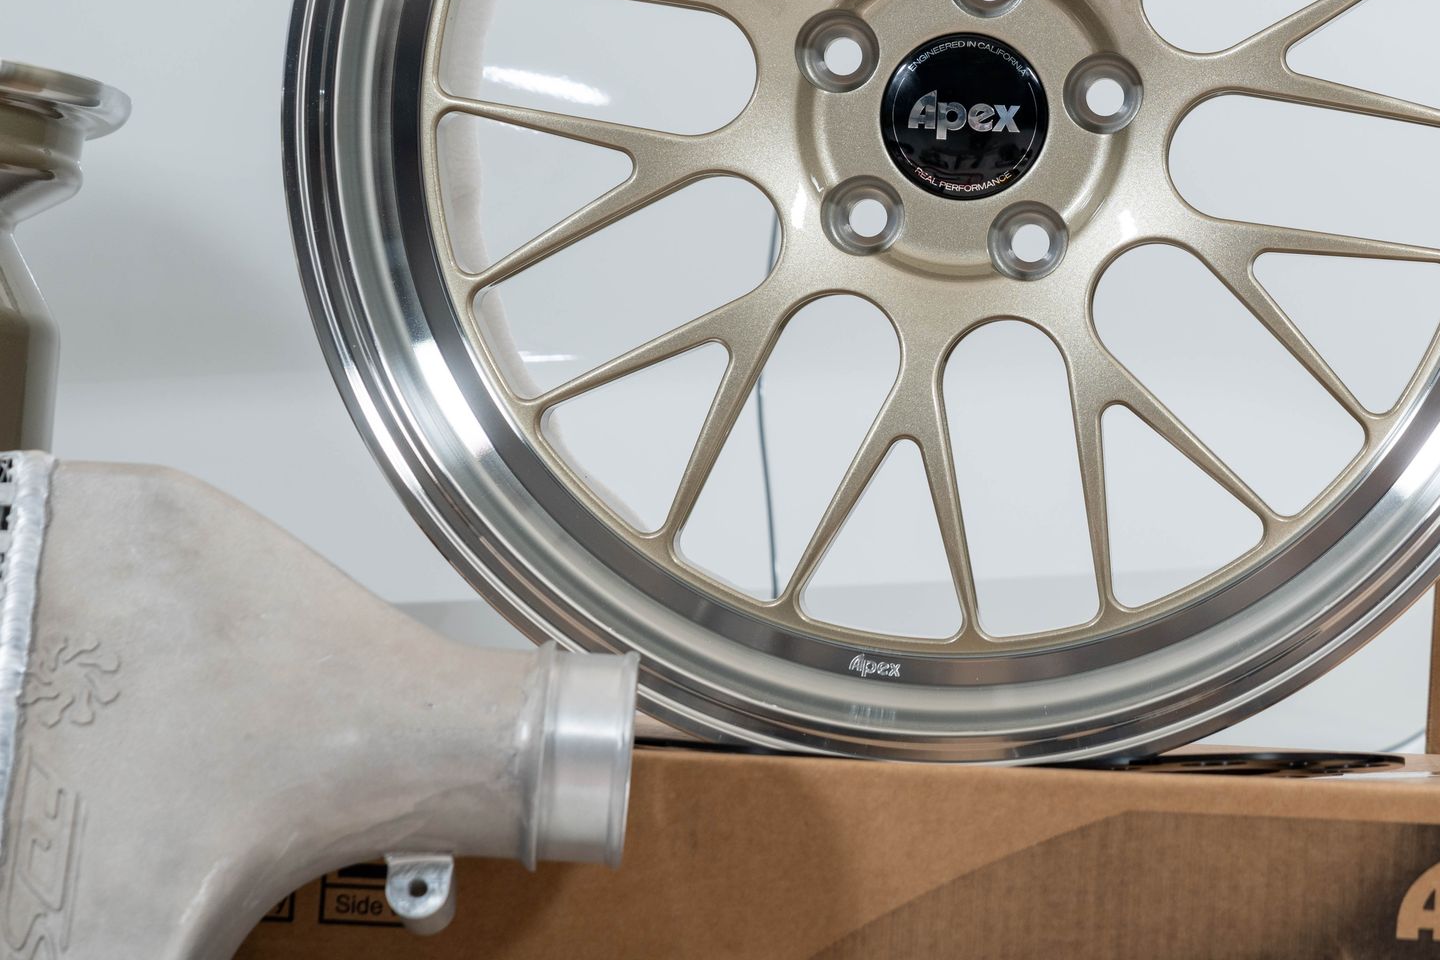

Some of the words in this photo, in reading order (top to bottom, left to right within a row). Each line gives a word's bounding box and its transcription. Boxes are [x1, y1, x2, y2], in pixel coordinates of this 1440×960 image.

[908, 40, 965, 72] ENGINEERED
[978, 42, 1027, 76] CALIFORNIA
[908, 90, 1020, 140] Apex
[914, 166, 937, 186] REAL
[938, 170, 1012, 192] PERFORMANCE
[848, 654, 901, 677] Apex
[335, 894, 384, 916] Side
